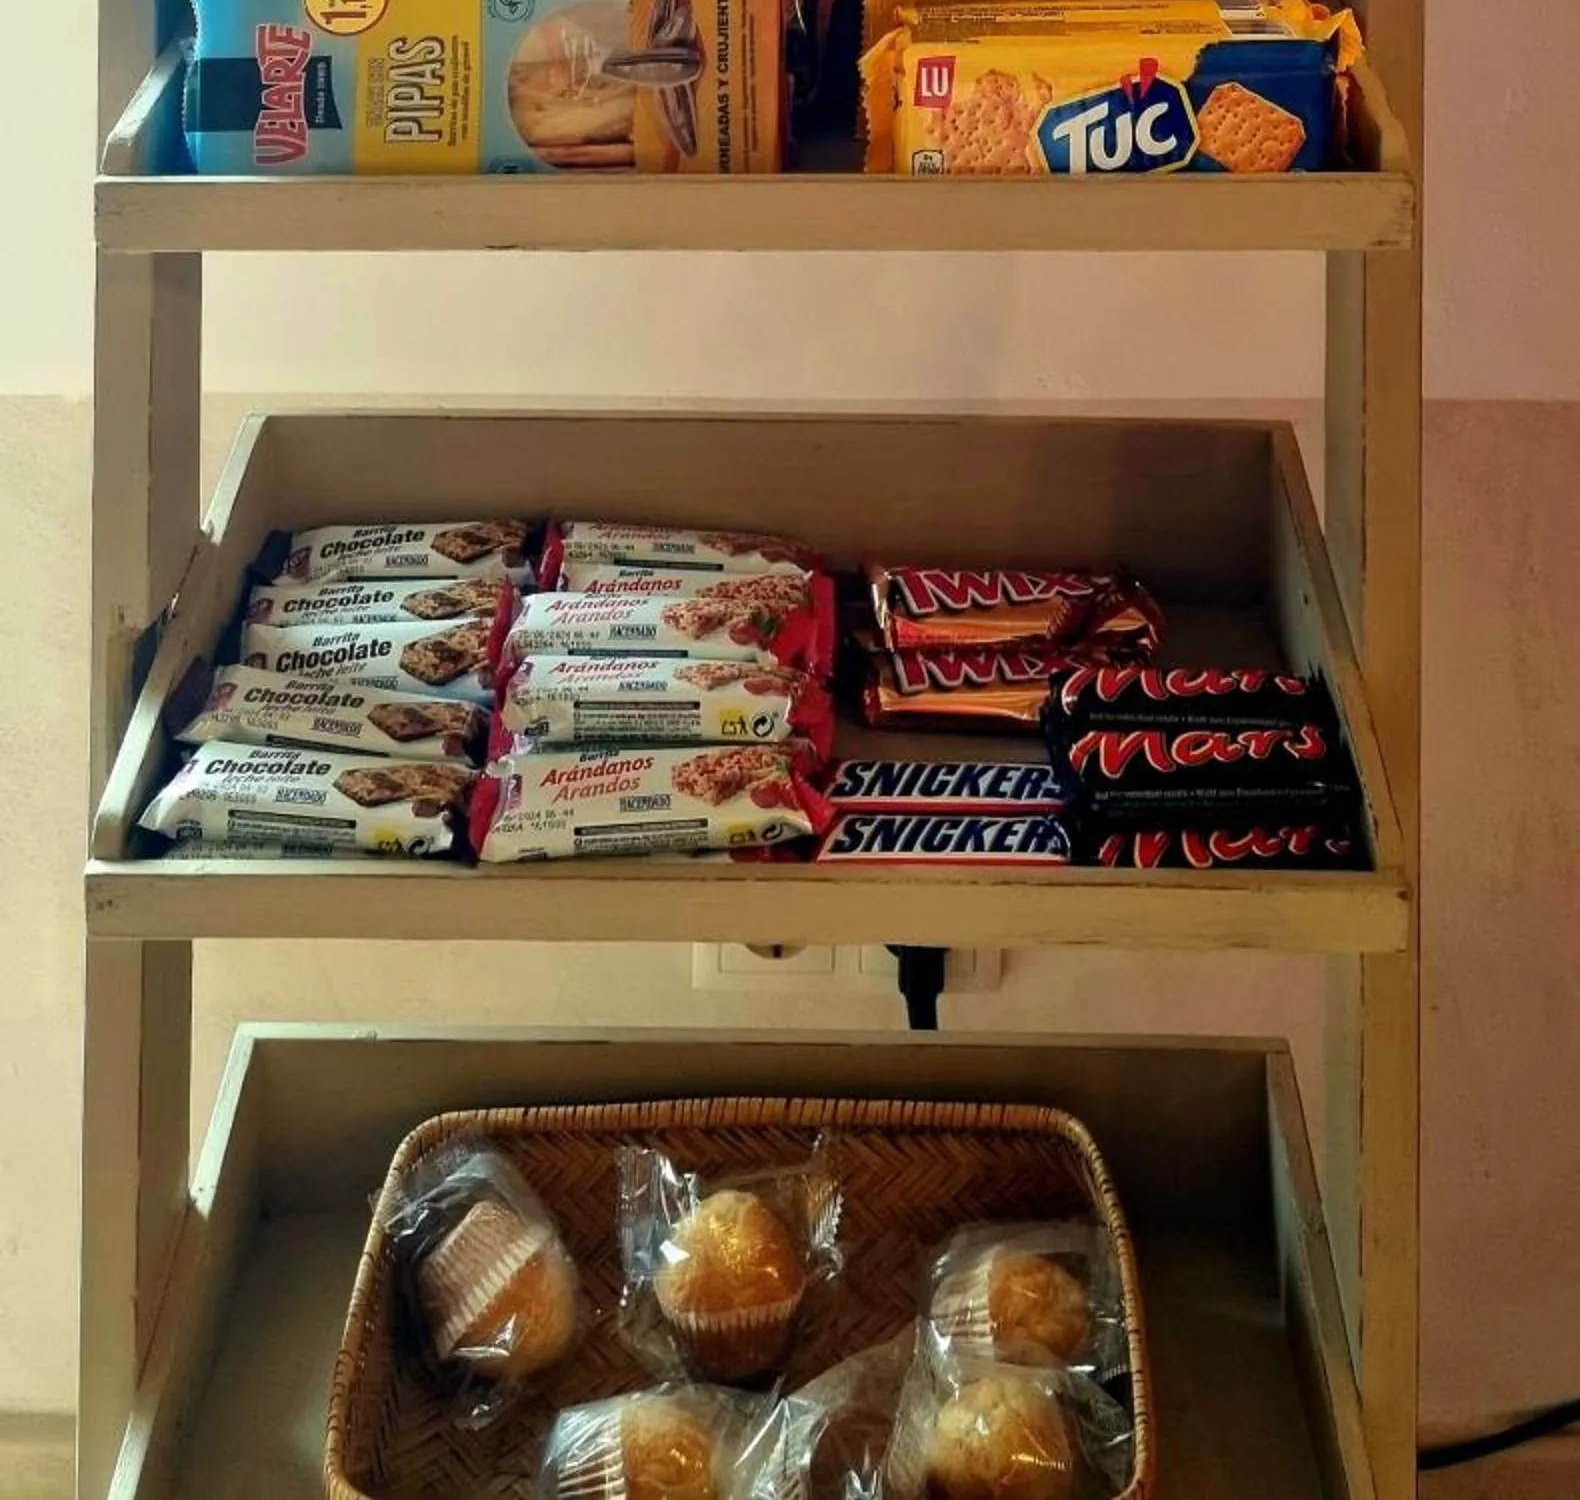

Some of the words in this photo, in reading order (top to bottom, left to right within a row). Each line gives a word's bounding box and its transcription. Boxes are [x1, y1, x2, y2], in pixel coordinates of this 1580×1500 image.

[384, 35, 445, 143] PIPAS
[716, 78, 729, 89] Y
[920, 66, 949, 98] LU
[320, 529, 426, 558] Chocolate
[584, 578, 683, 594] Arándanos
[283, 589, 395, 613] Chocolate
[275, 638, 393, 674] Chocolate
[244, 687, 365, 709] Chocolate
[205, 759, 332, 776] Chocolate
[539, 755, 655, 788] Arándanos
[552, 776, 641, 804] Arandos
[827, 815, 1068, 854] SNICKER
